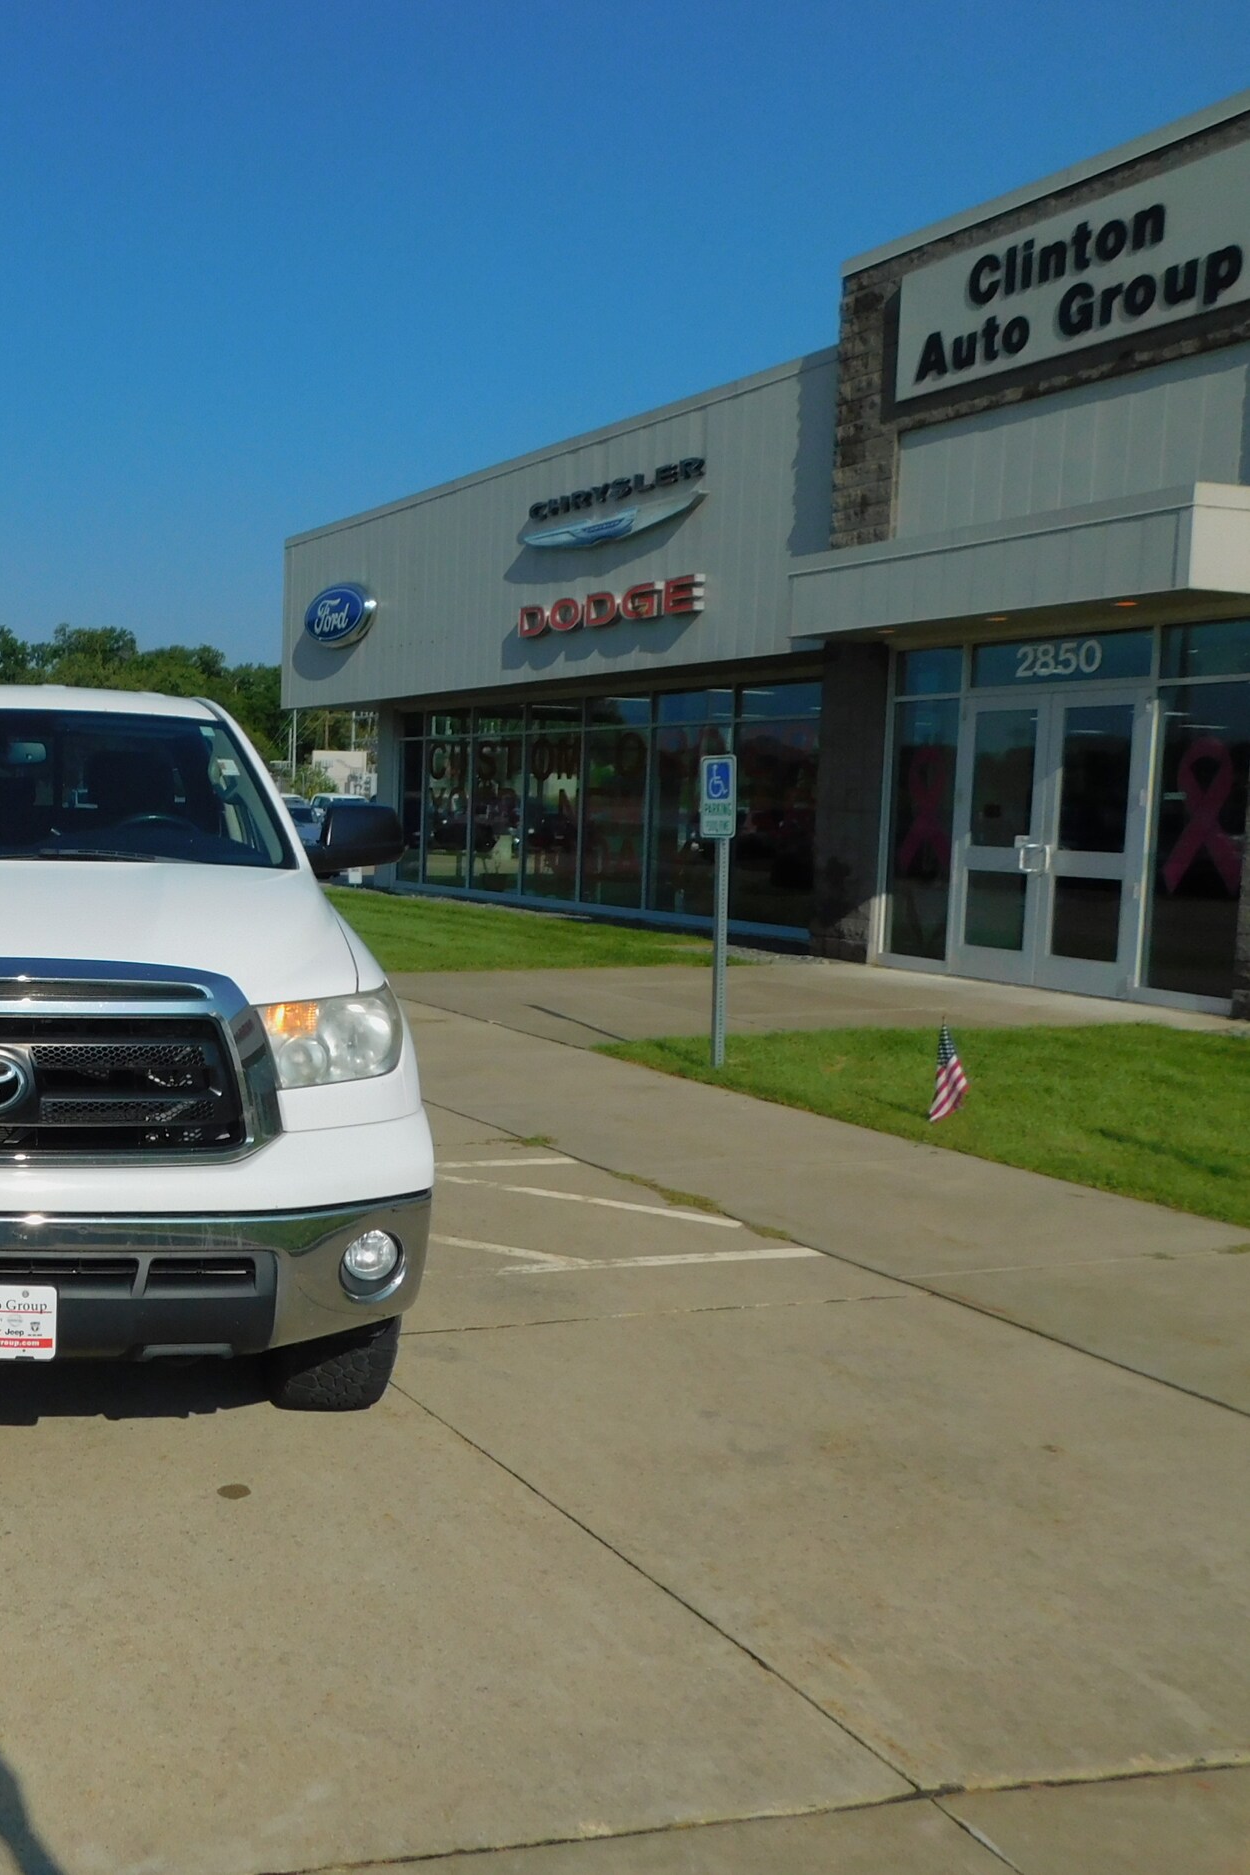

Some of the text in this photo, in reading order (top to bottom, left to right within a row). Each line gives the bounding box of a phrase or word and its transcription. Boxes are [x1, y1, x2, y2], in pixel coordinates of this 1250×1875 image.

[969, 203, 1165, 305] Clinton
[914, 245, 1242, 383] Auto Group
[529, 457, 705, 521] CHRYSLER
[313, 598, 349, 633] Ford
[518, 573, 706, 638] DODGE
[1015, 639, 1102, 677] 2850
[429, 736, 578, 781] CUSTOM
[6, 1300, 47, 1314] Group
[5, 1328, 24, 1337] Jeep
